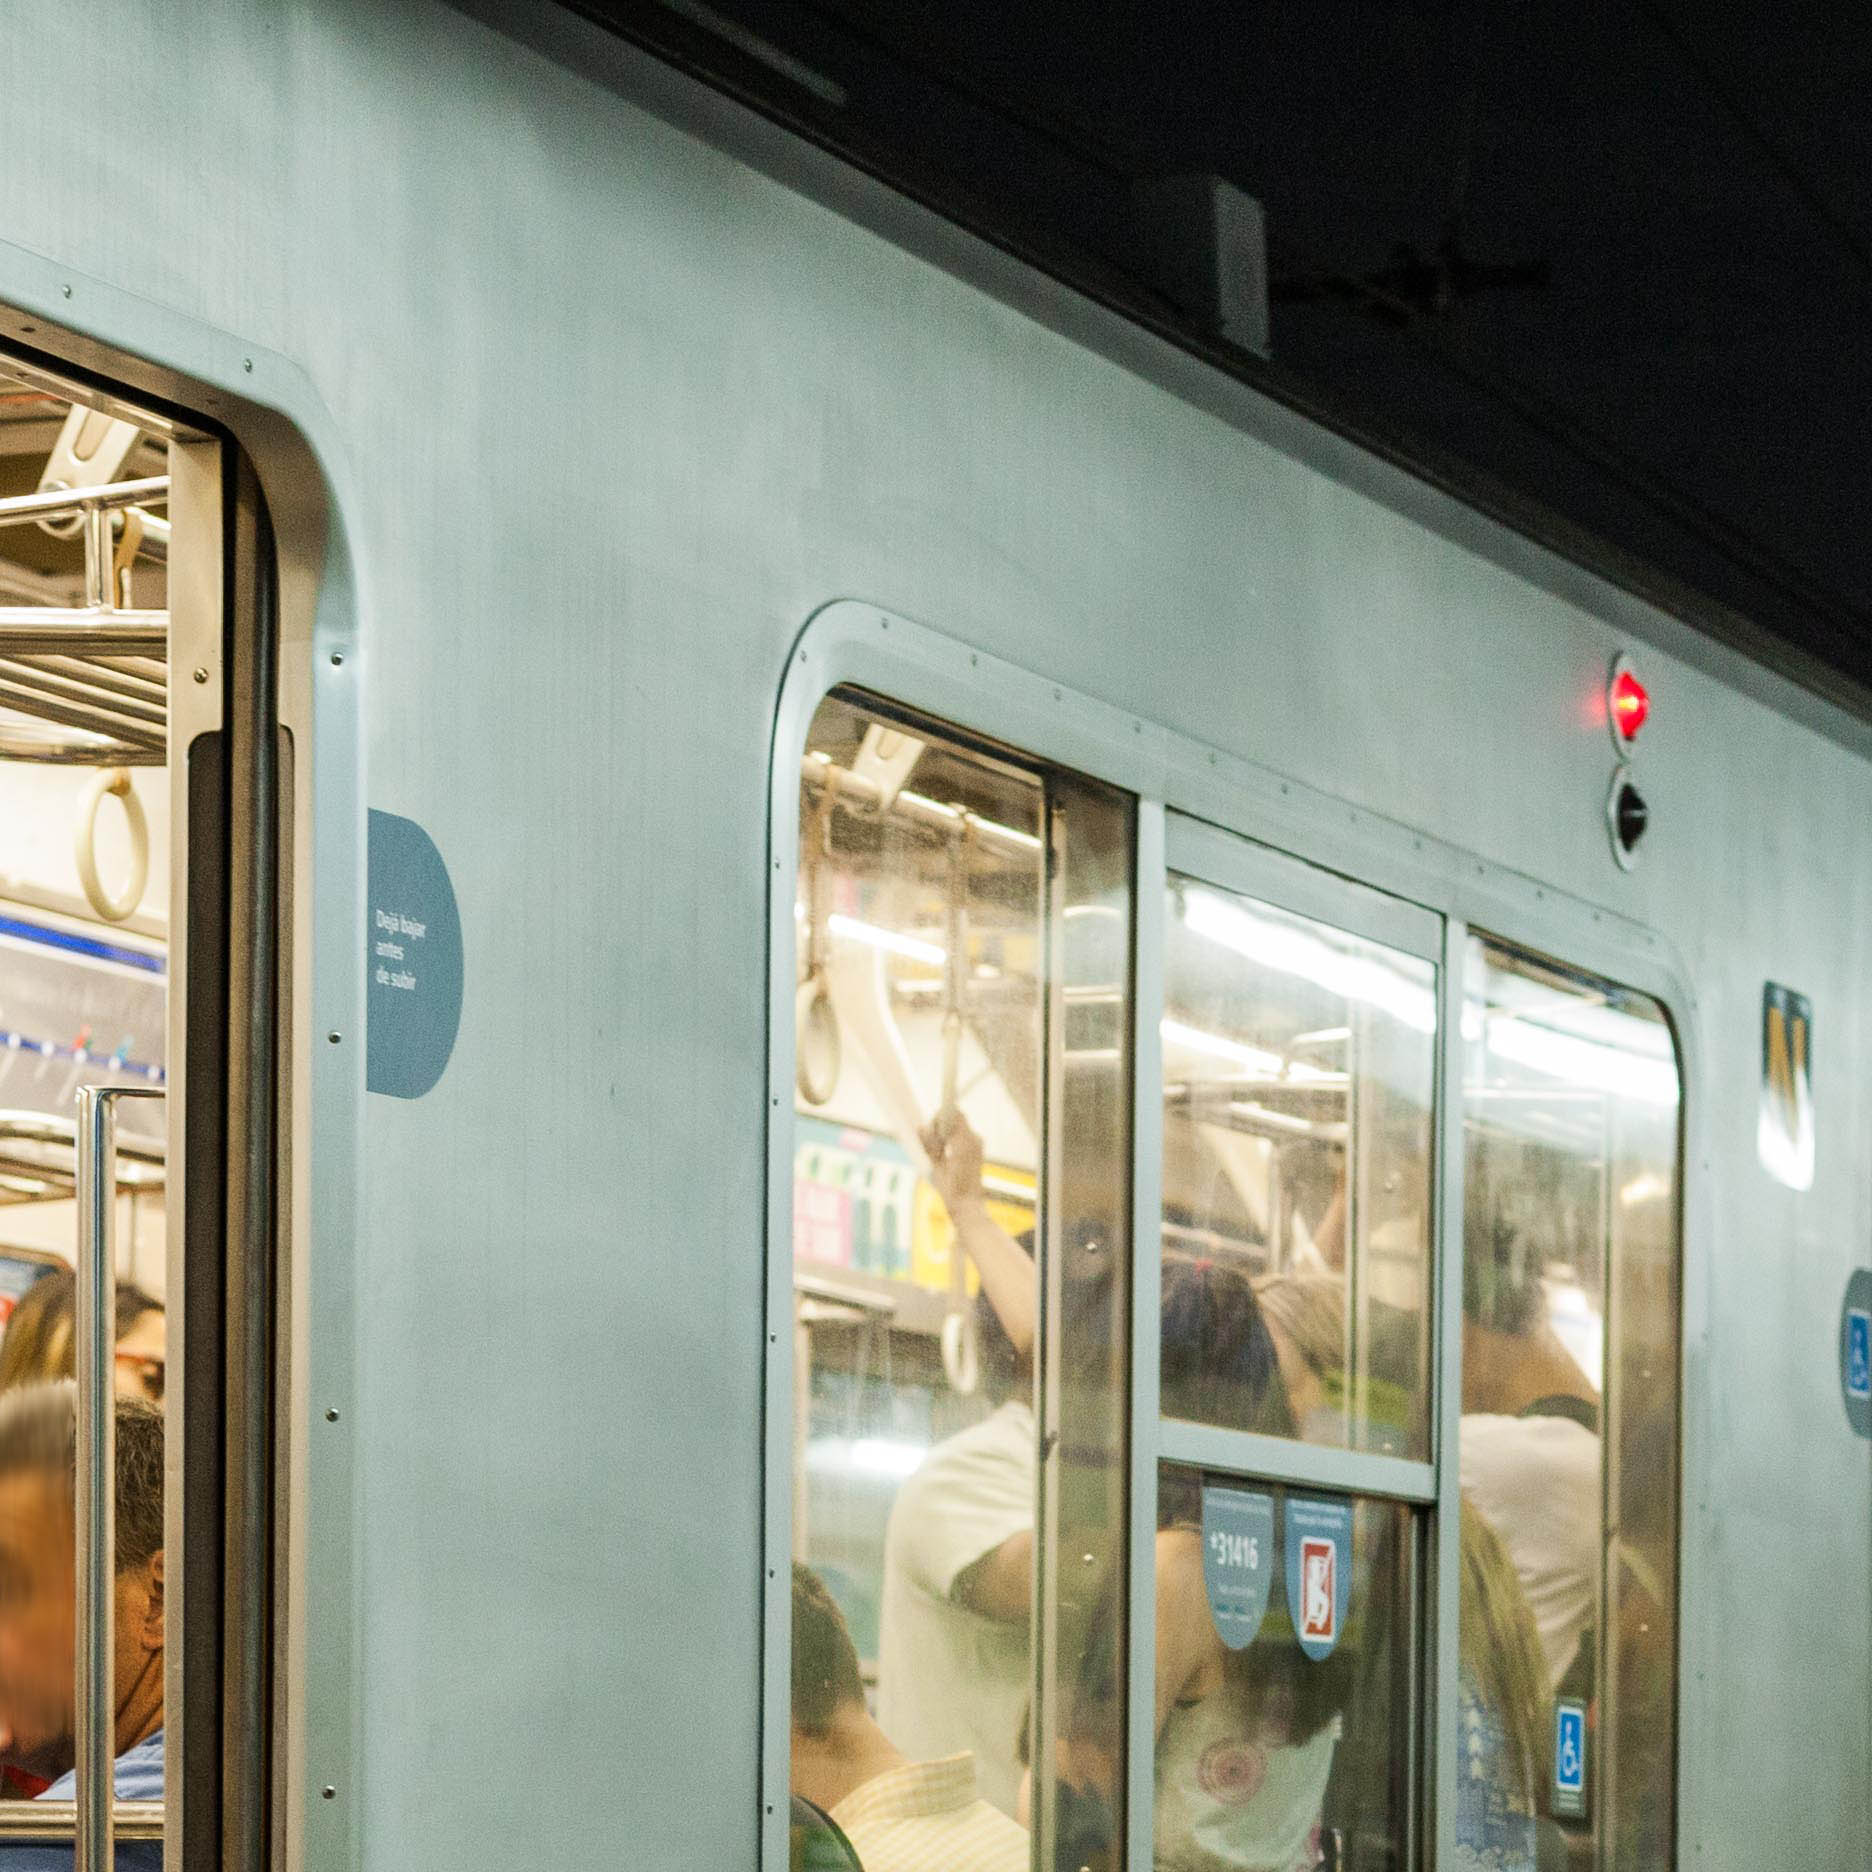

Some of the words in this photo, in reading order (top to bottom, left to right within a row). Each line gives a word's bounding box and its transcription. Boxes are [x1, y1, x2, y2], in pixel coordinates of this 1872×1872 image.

[400, 914, 426, 940] bajar
[376, 941, 404, 960] antes
[376, 965, 389, 985] de
[391, 970, 415, 990] subir
